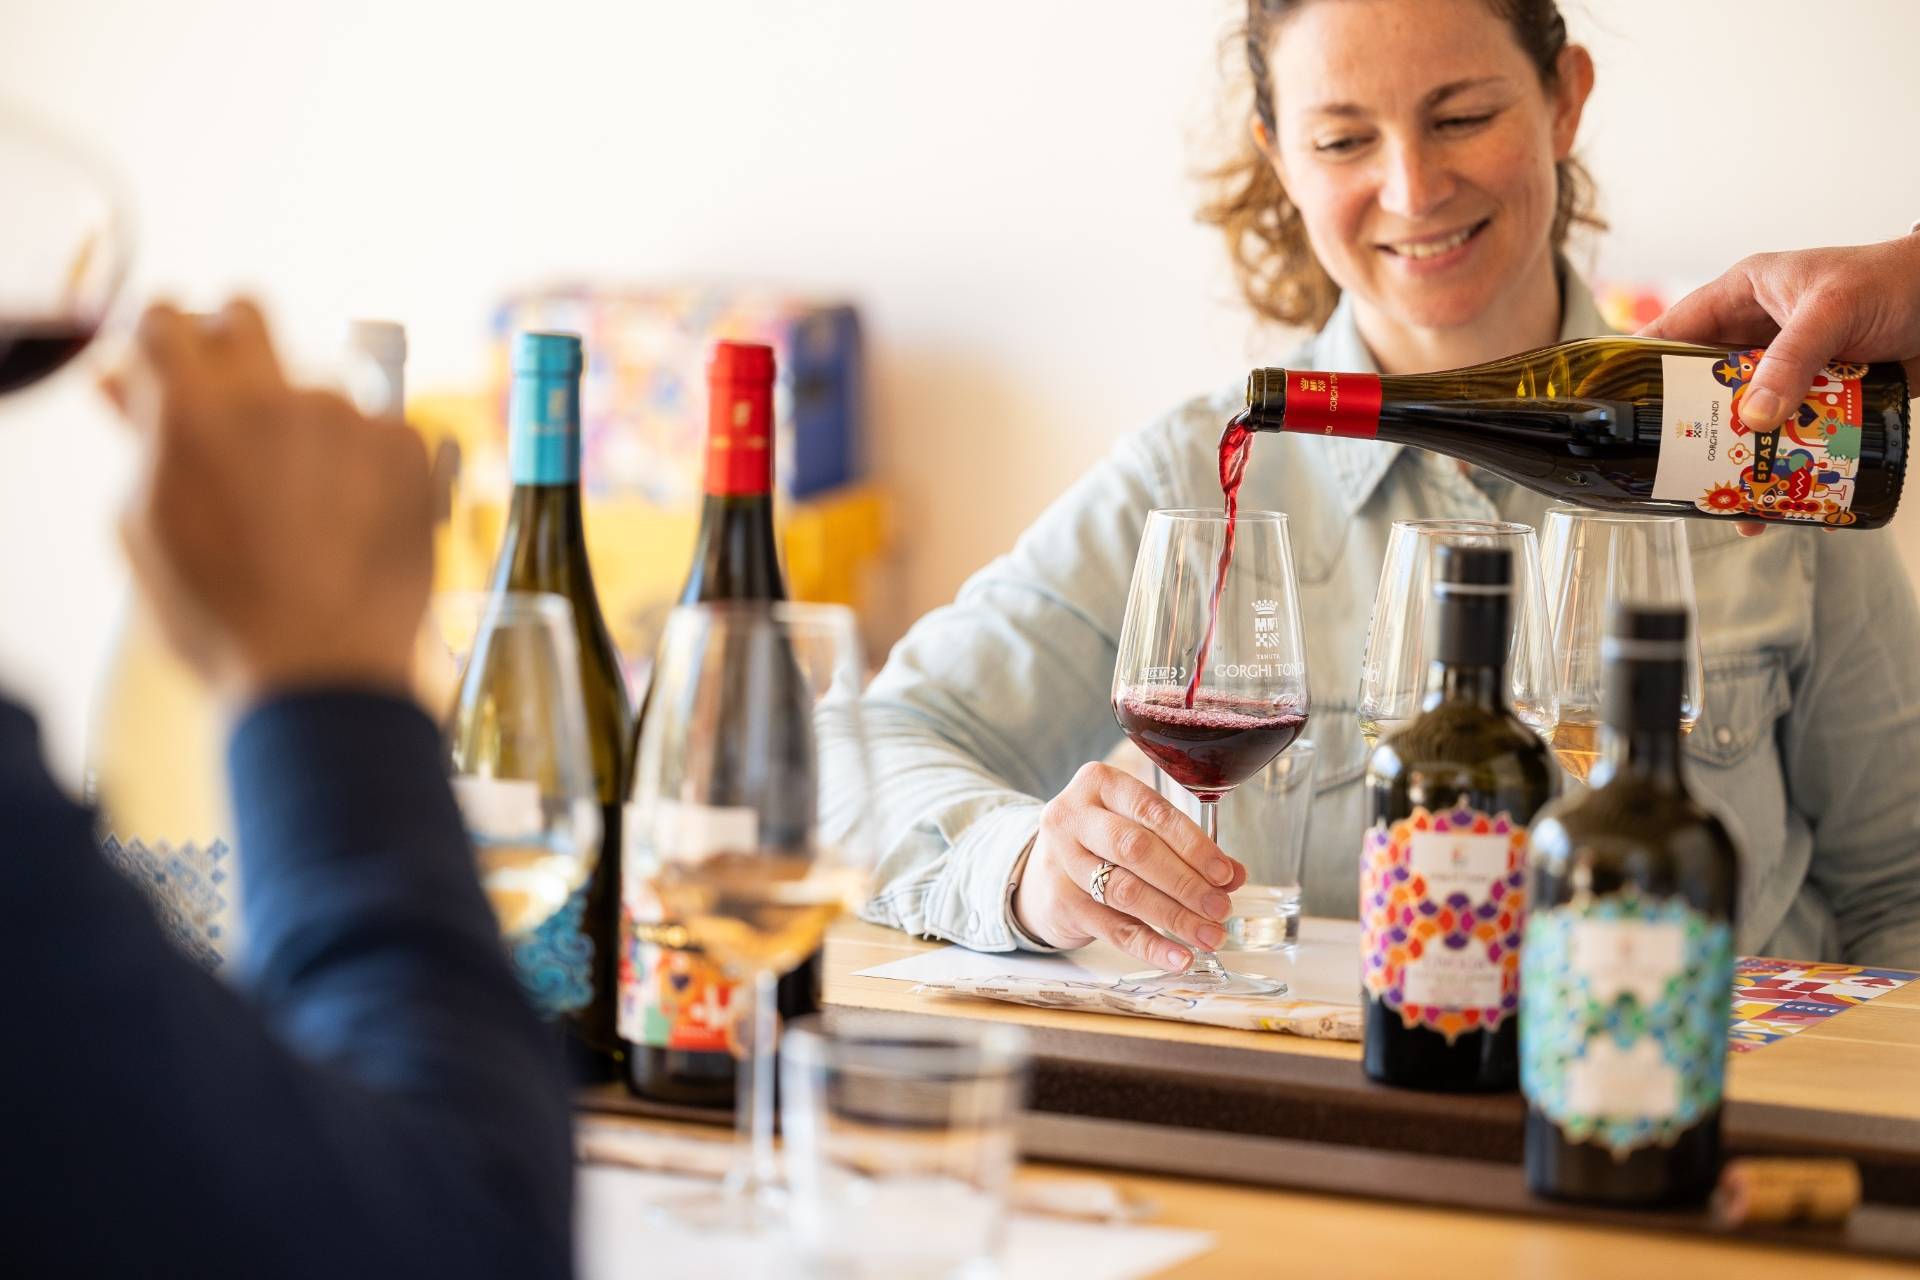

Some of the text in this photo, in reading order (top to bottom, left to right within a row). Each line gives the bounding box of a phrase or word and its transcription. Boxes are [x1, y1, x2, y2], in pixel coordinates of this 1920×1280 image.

[1707, 400, 1720, 461] GORGHI TONDI
[1757, 431, 1772, 480] SPAS
[1214, 664, 1272, 679] GORGHI
